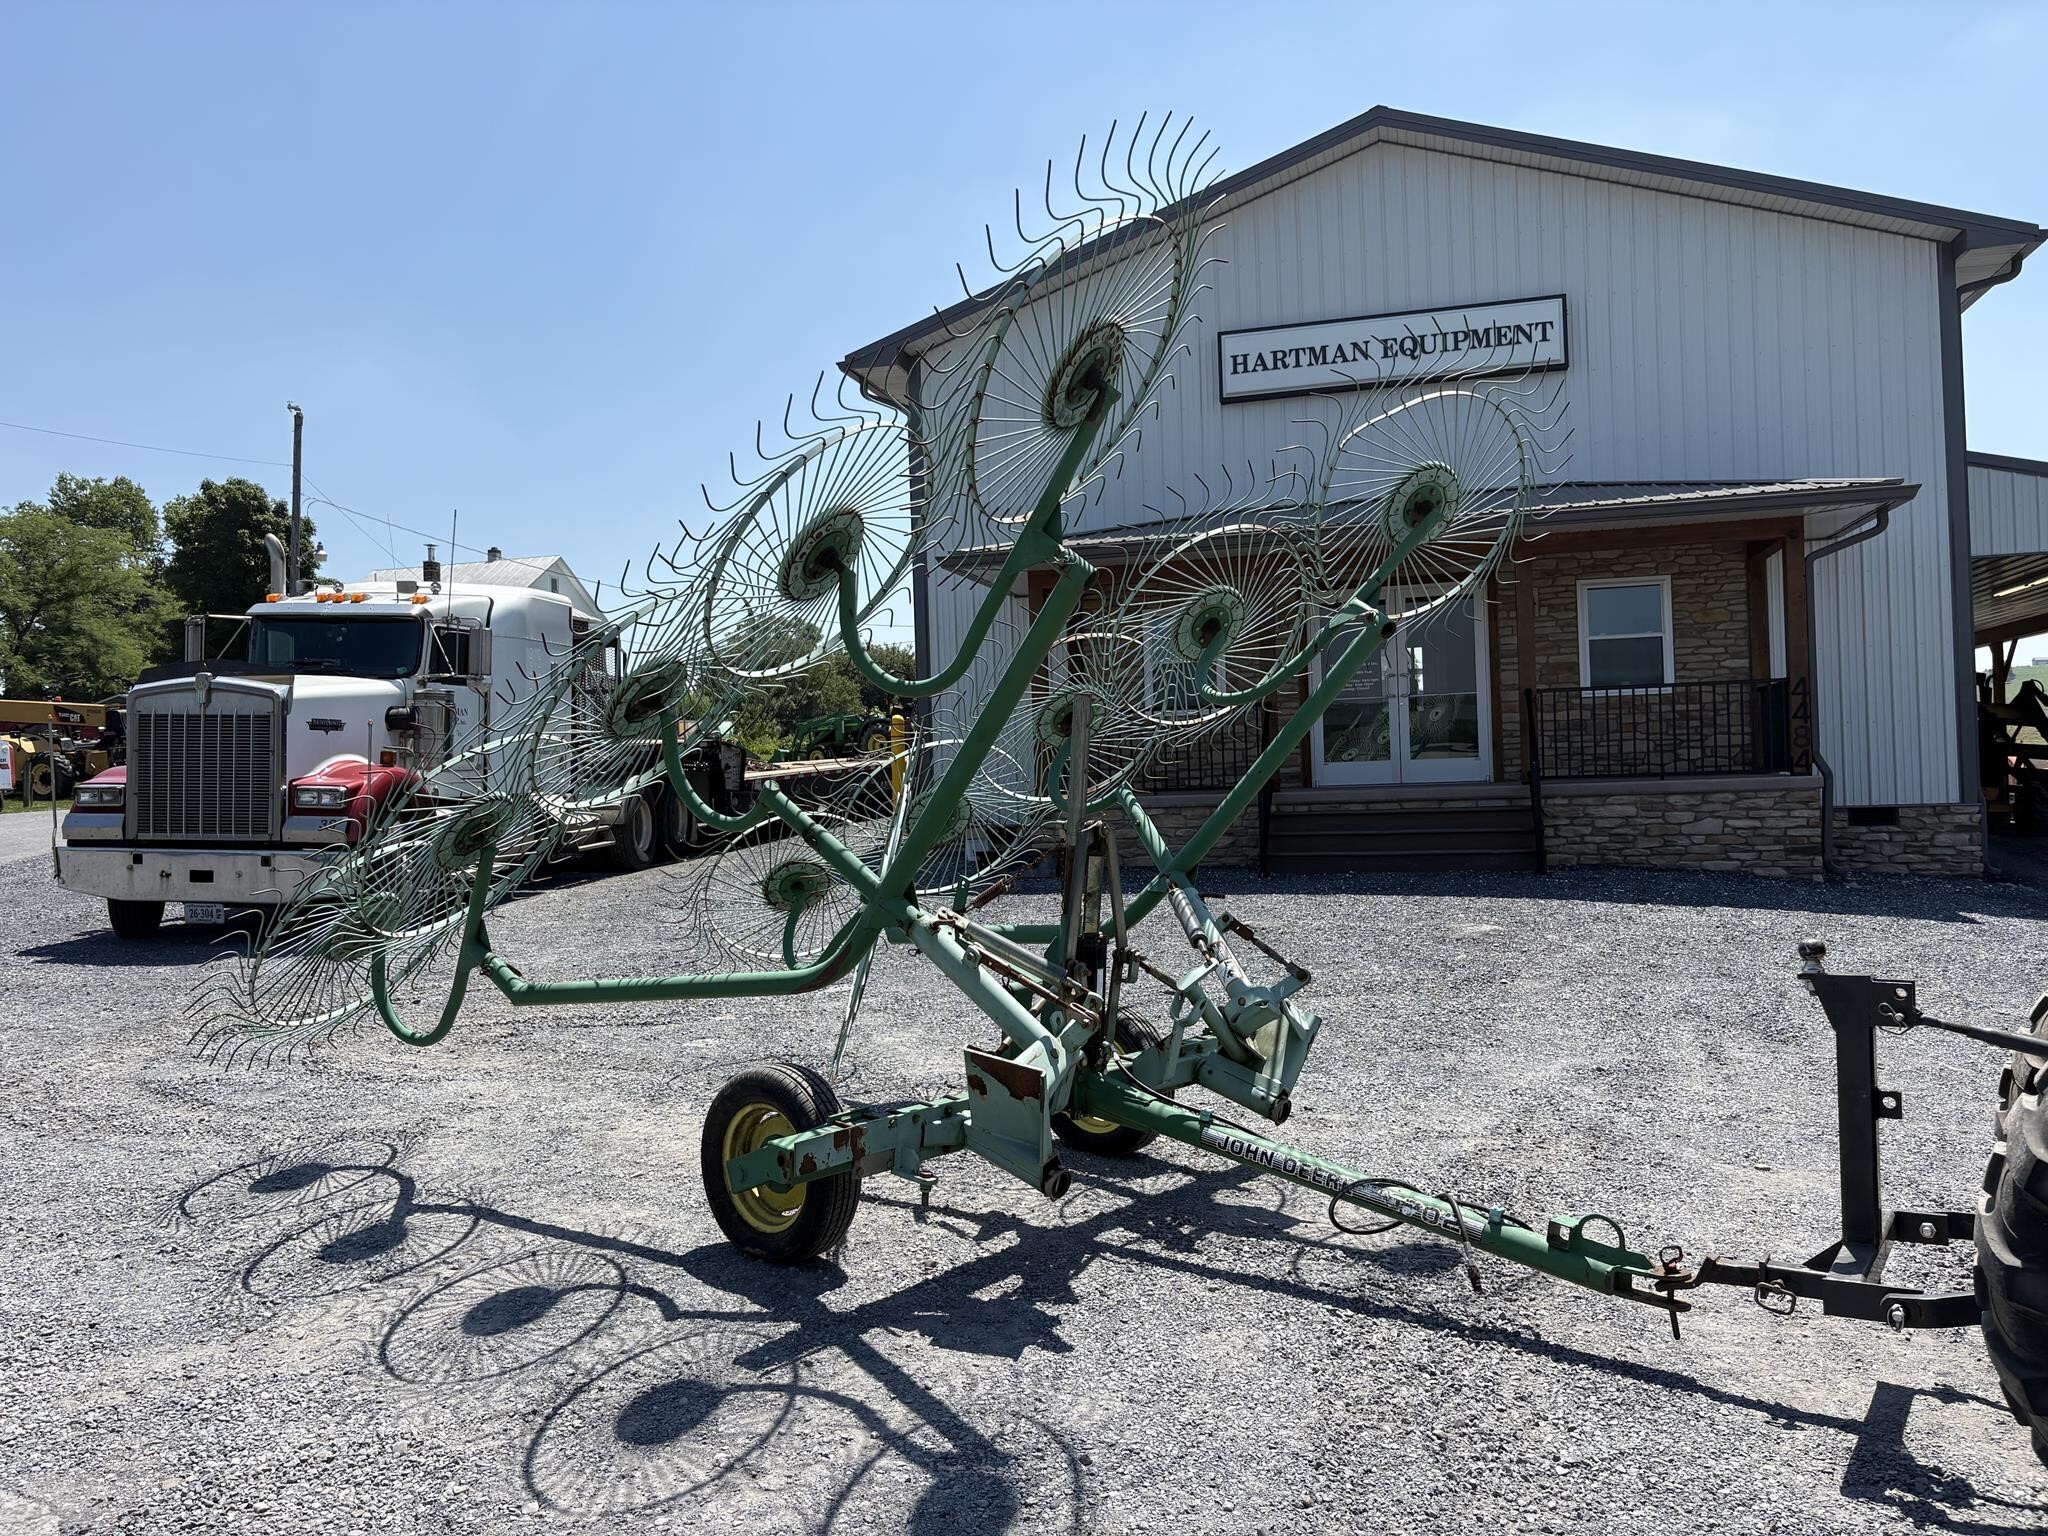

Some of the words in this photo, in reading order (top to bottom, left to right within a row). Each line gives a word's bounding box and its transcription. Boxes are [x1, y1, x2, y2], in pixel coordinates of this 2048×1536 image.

[1230, 340, 1370, 375] HARTMAN
[1381, 320, 1555, 360] EQUIPMENT
[70, 713, 81, 722] CAT
[1216, 1135, 1275, 1168] JOHN
